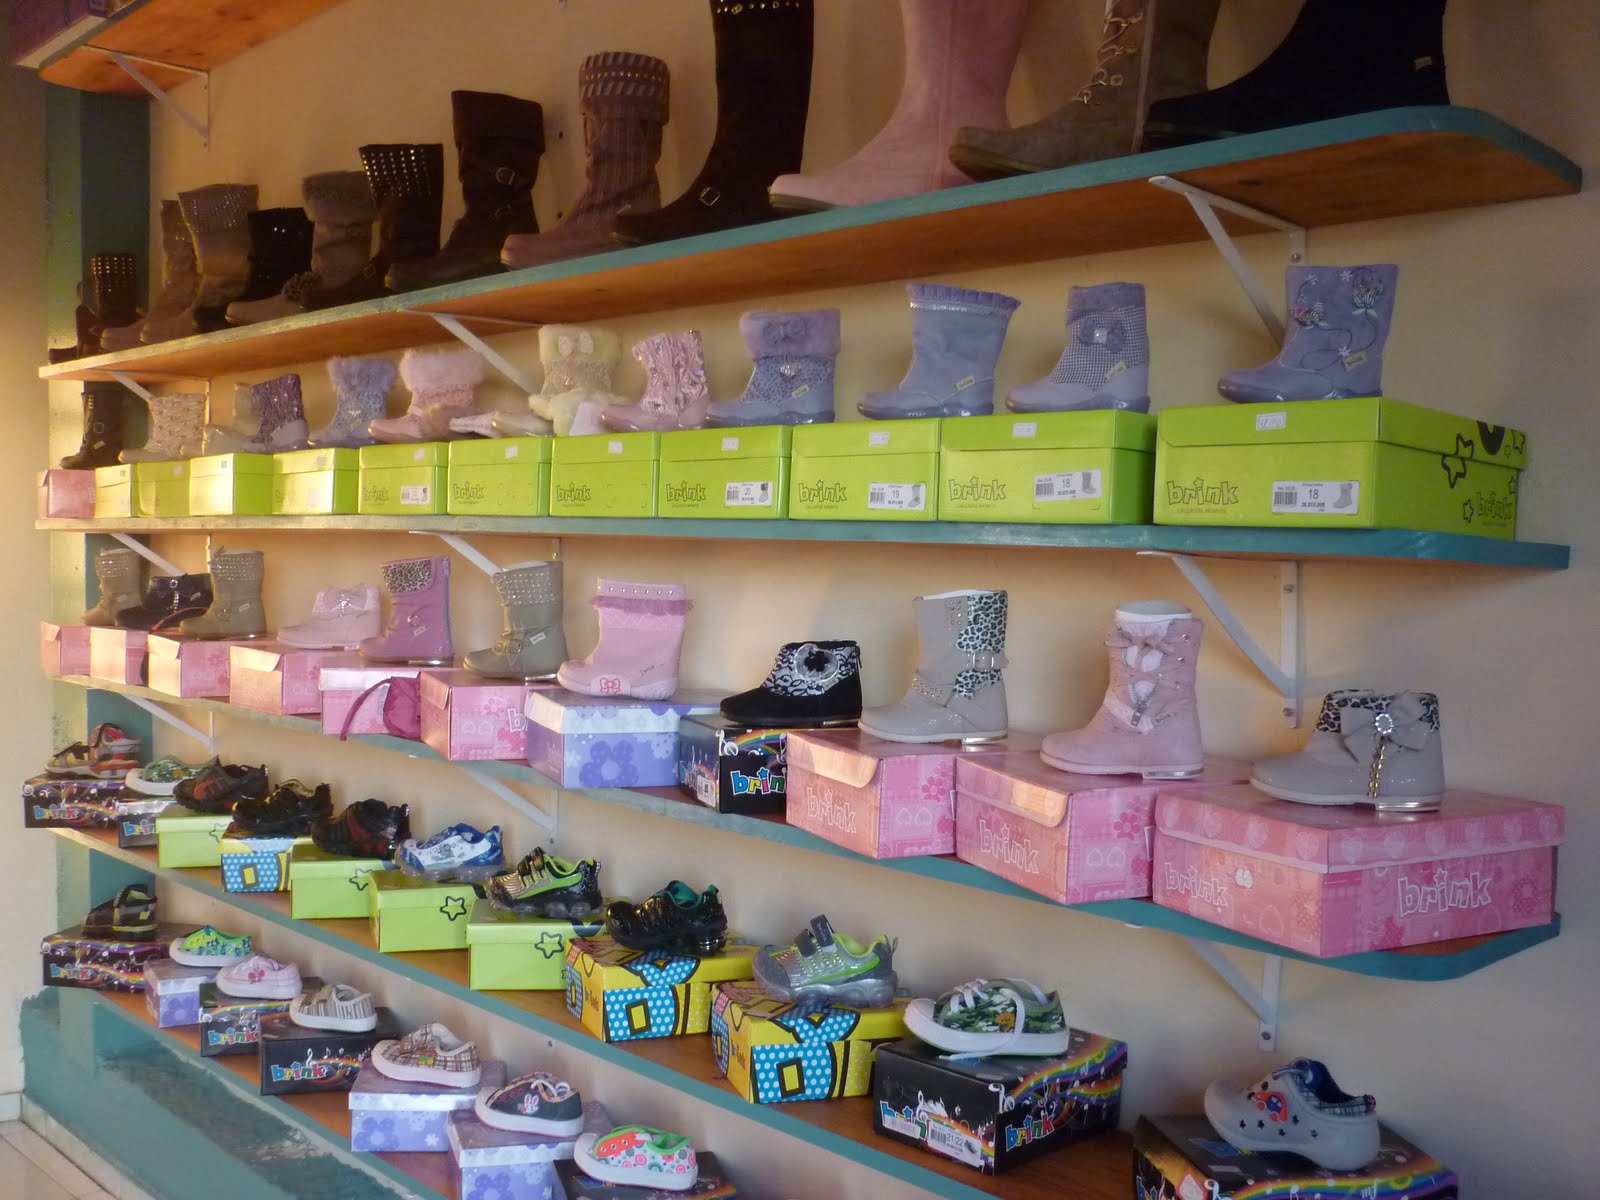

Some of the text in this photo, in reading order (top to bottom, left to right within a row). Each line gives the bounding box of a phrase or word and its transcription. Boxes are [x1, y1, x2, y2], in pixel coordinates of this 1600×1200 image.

[453, 481, 484, 500] brink
[556, 482, 591, 501] brink
[665, 481, 706, 502] brink
[798, 480, 847, 503] brink
[892, 489, 900, 499] 19
[948, 476, 1006, 502] brink
[1062, 478, 1071, 489] 18
[1166, 476, 1240, 506] brink
[1308, 488, 1319, 500] 18
[730, 766, 786, 796] brin
[33, 803, 79, 820] brink
[806, 786, 857, 833] brink
[979, 819, 1040, 874] brink
[1164, 862, 1229, 906] brink
[1397, 868, 1492, 917] brink
[50, 963, 92, 980] brink
[208, 1027, 259, 1046] brink
[270, 1061, 327, 1083] brink
[1005, 1113, 1055, 1152] brink
